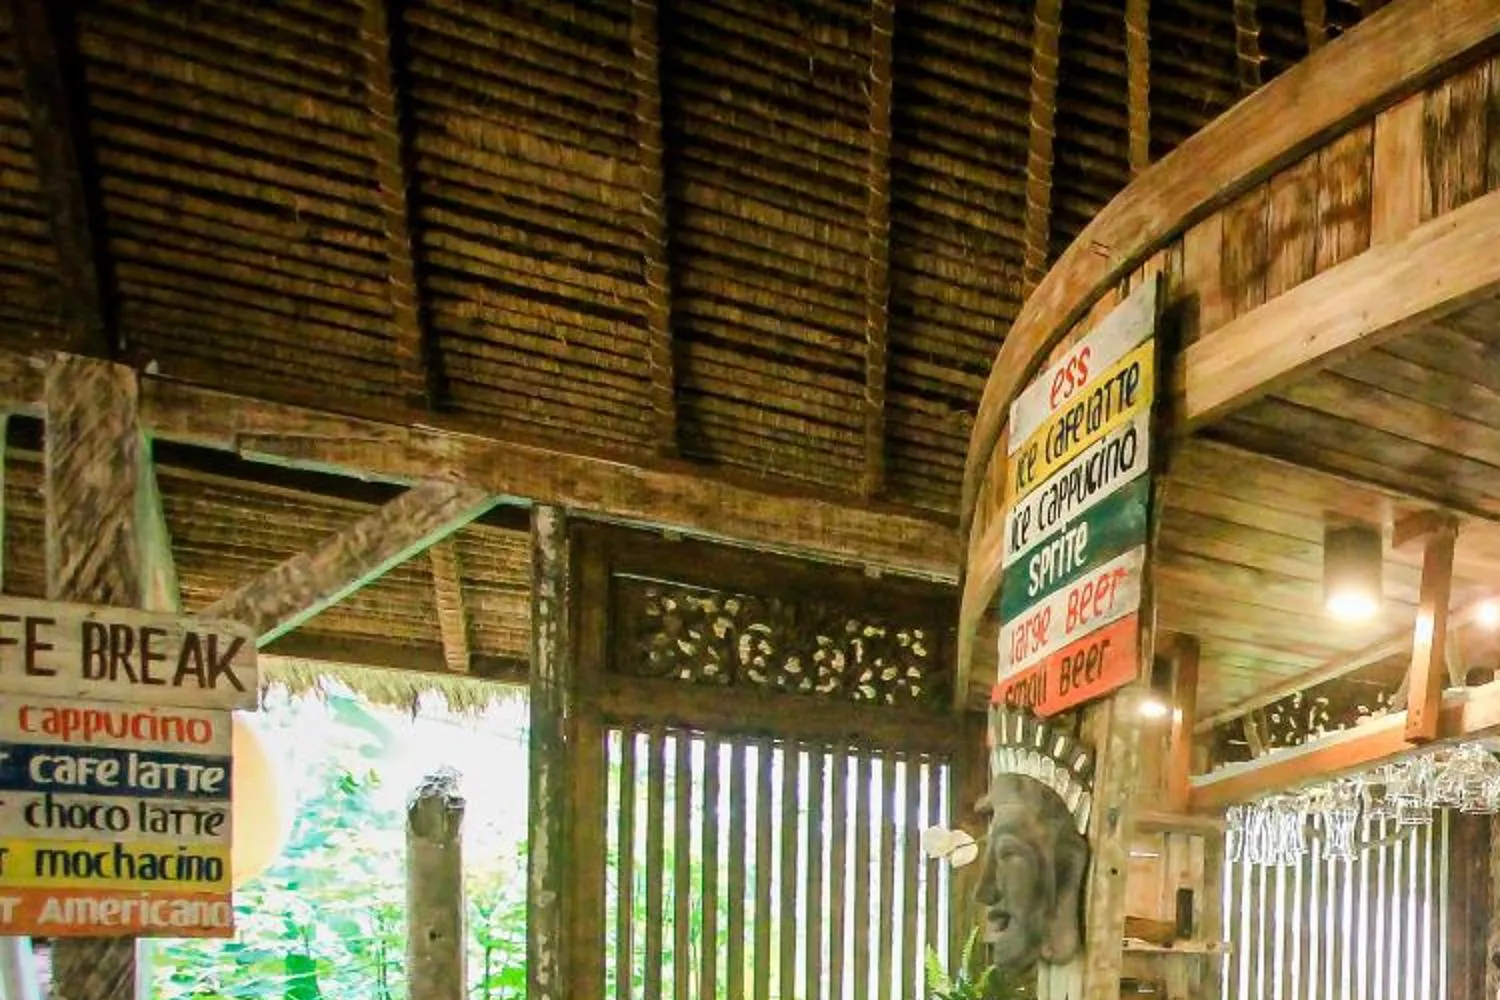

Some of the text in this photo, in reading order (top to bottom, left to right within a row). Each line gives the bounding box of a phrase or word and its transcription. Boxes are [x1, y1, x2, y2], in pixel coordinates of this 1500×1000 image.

[1064, 567, 1129, 635] Beer
[81, 621, 247, 693] BREAK
[1059, 637, 1111, 697] Beer
[18, 703, 214, 745] cappucino
[24, 790, 131, 833] choco
[34, 842, 224, 882] mochacino
